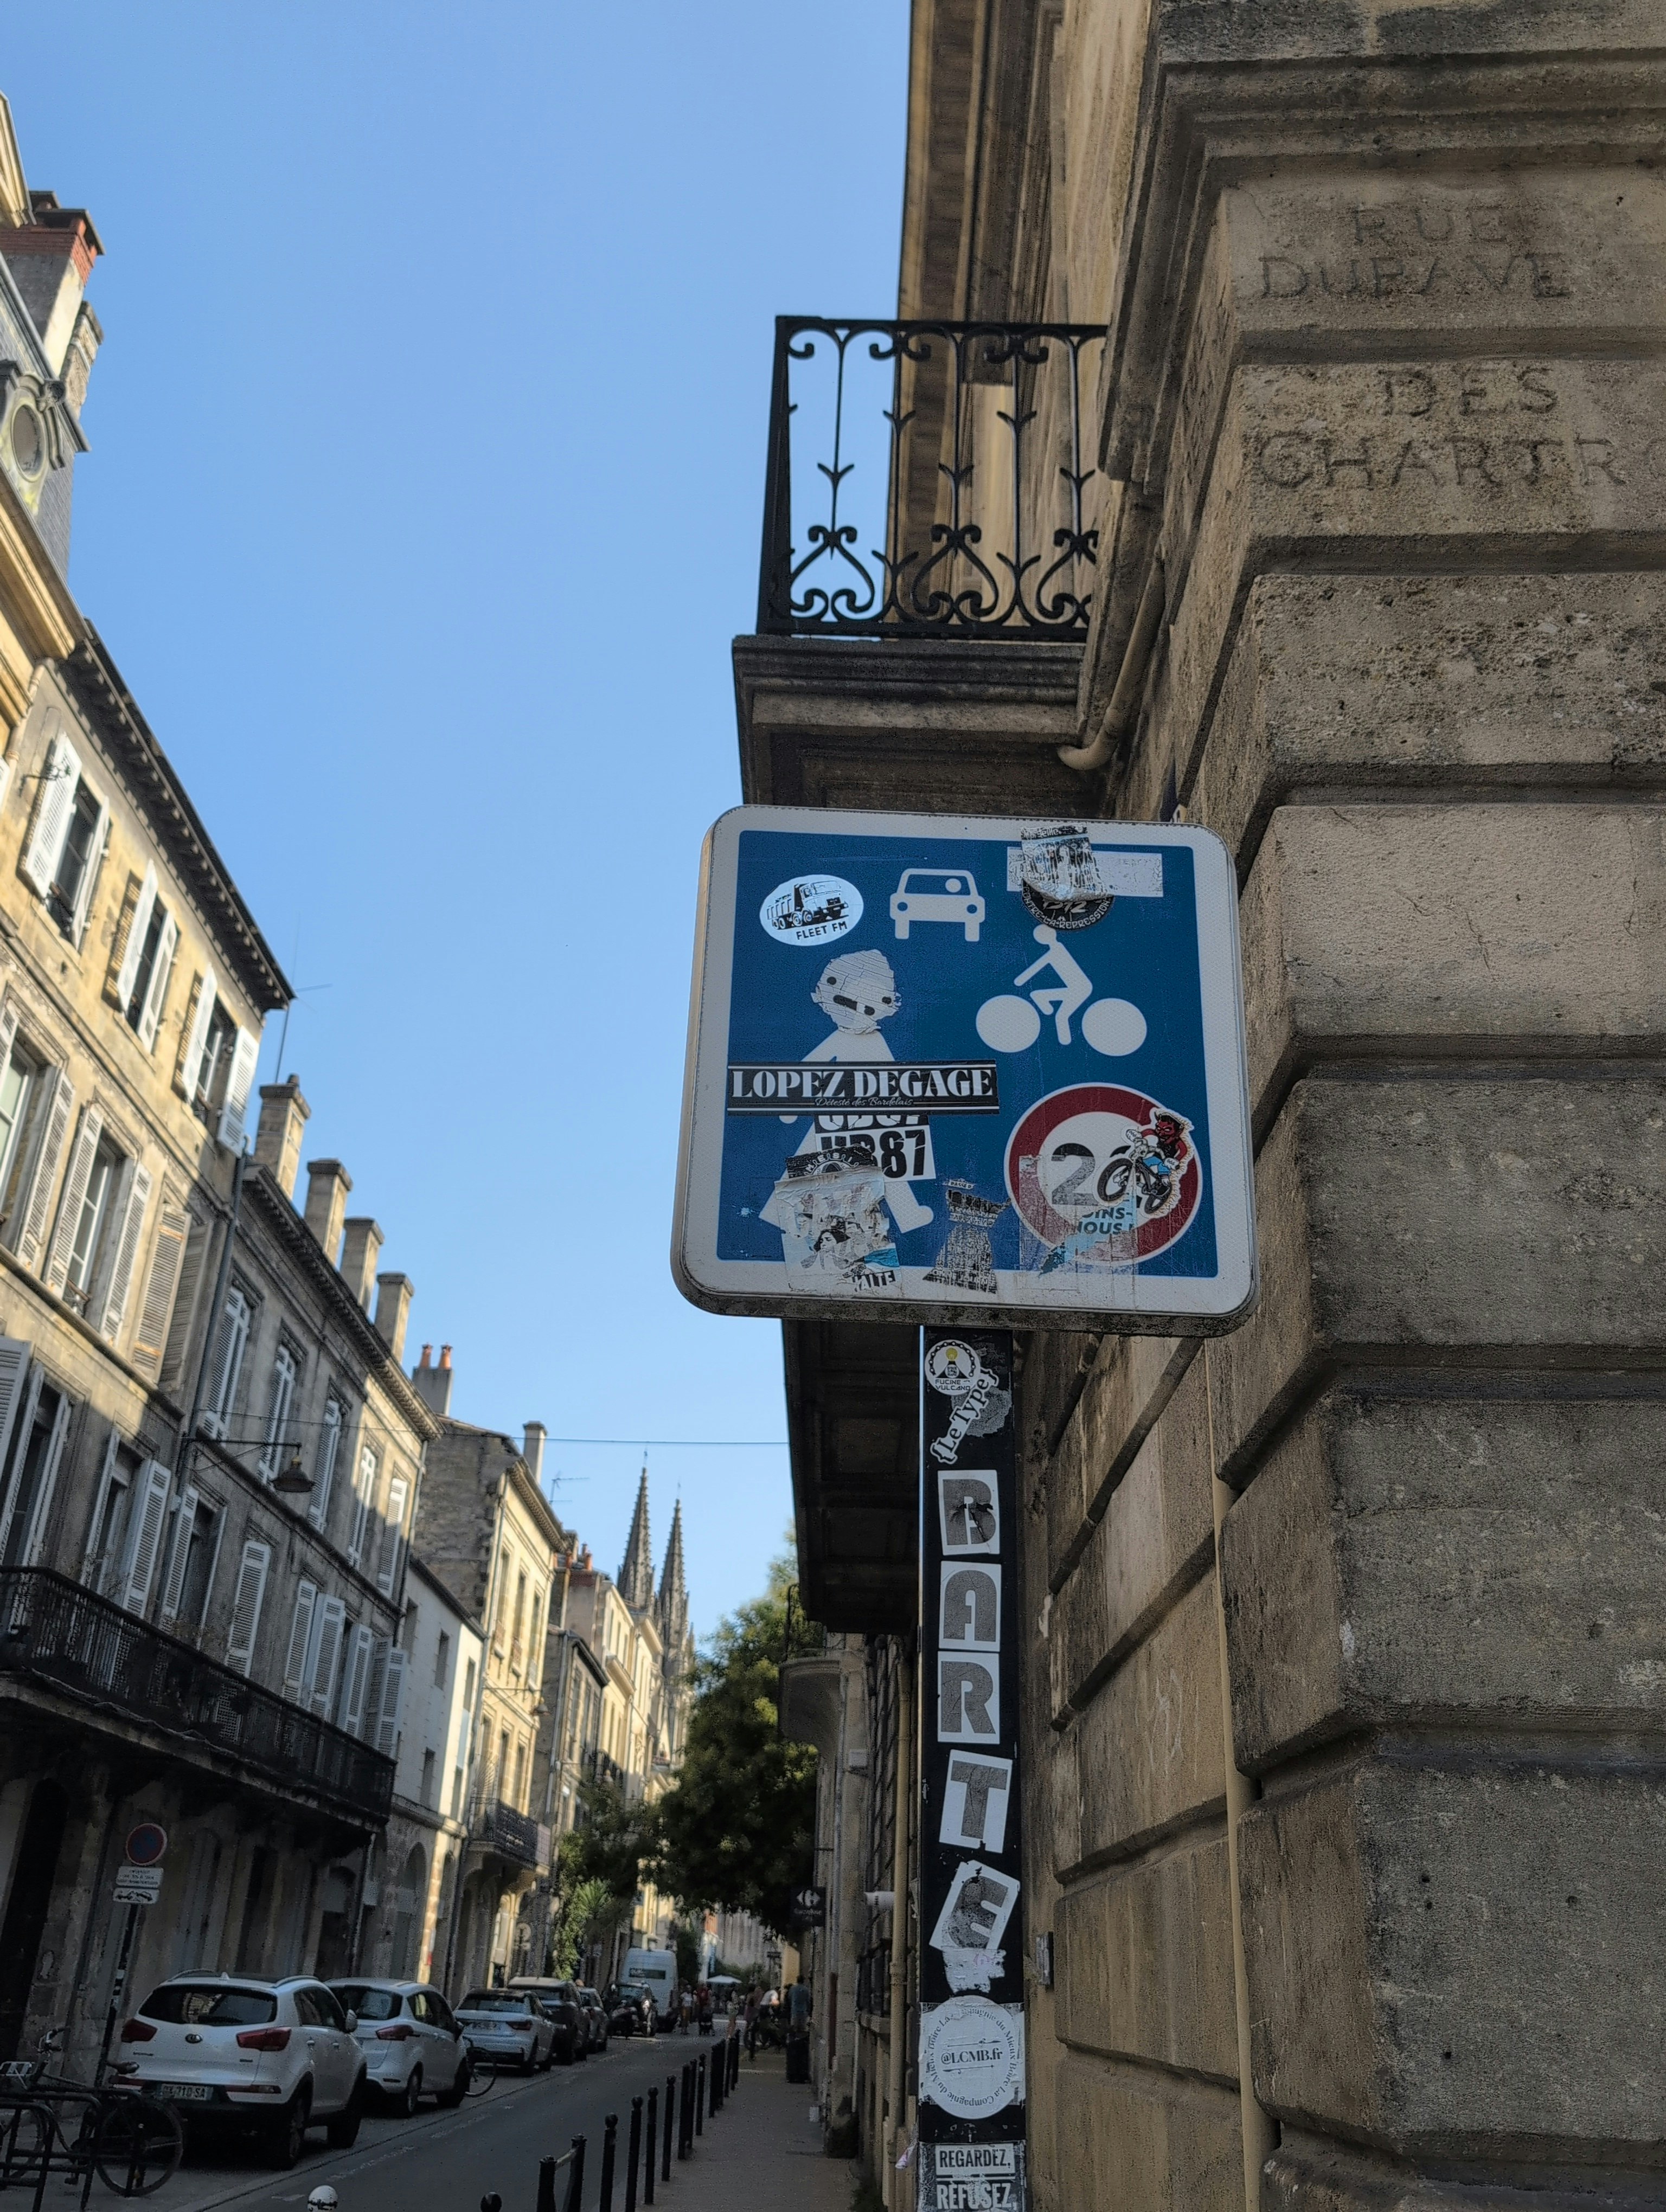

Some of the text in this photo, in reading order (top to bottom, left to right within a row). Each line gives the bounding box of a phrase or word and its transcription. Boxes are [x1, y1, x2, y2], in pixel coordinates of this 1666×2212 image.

[1355, 204, 1509, 243] RUE
[1382, 366, 1558, 417] DES
[796, 921, 847, 940] FLEET FM
[732, 1069, 993, 1098] LOPEZ DEGAGE
[851, 1097, 866, 1107] des
[868, 1097, 913, 1107] Bordelais
[941, 2048, 1003, 2065] @LCMB.fr
[947, 2091, 995, 2107] Compagnie
[939, 2149, 1011, 2169] REGARDEZ,
